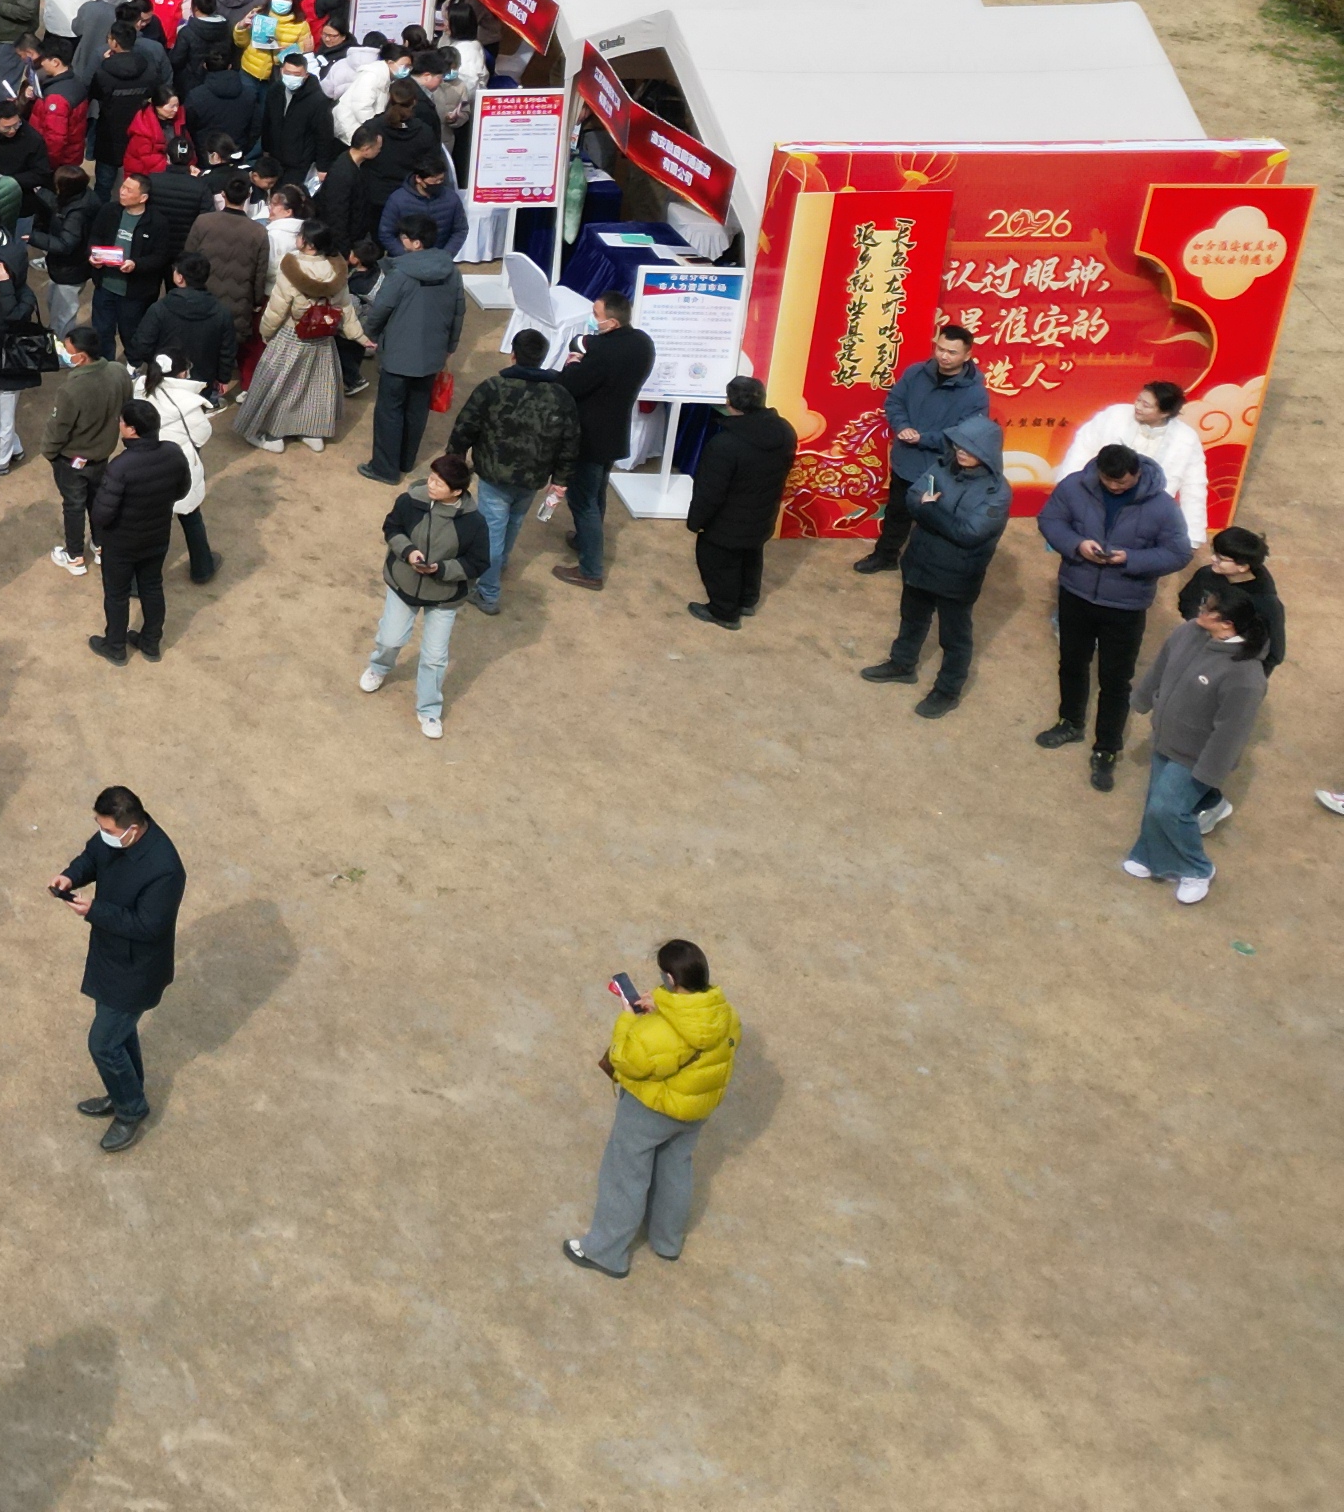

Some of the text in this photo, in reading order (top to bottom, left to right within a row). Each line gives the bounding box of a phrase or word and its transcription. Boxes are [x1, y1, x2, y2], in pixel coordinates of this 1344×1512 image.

[662, 156, 694, 187] 有限公司
[984, 208, 1073, 238] 2026
